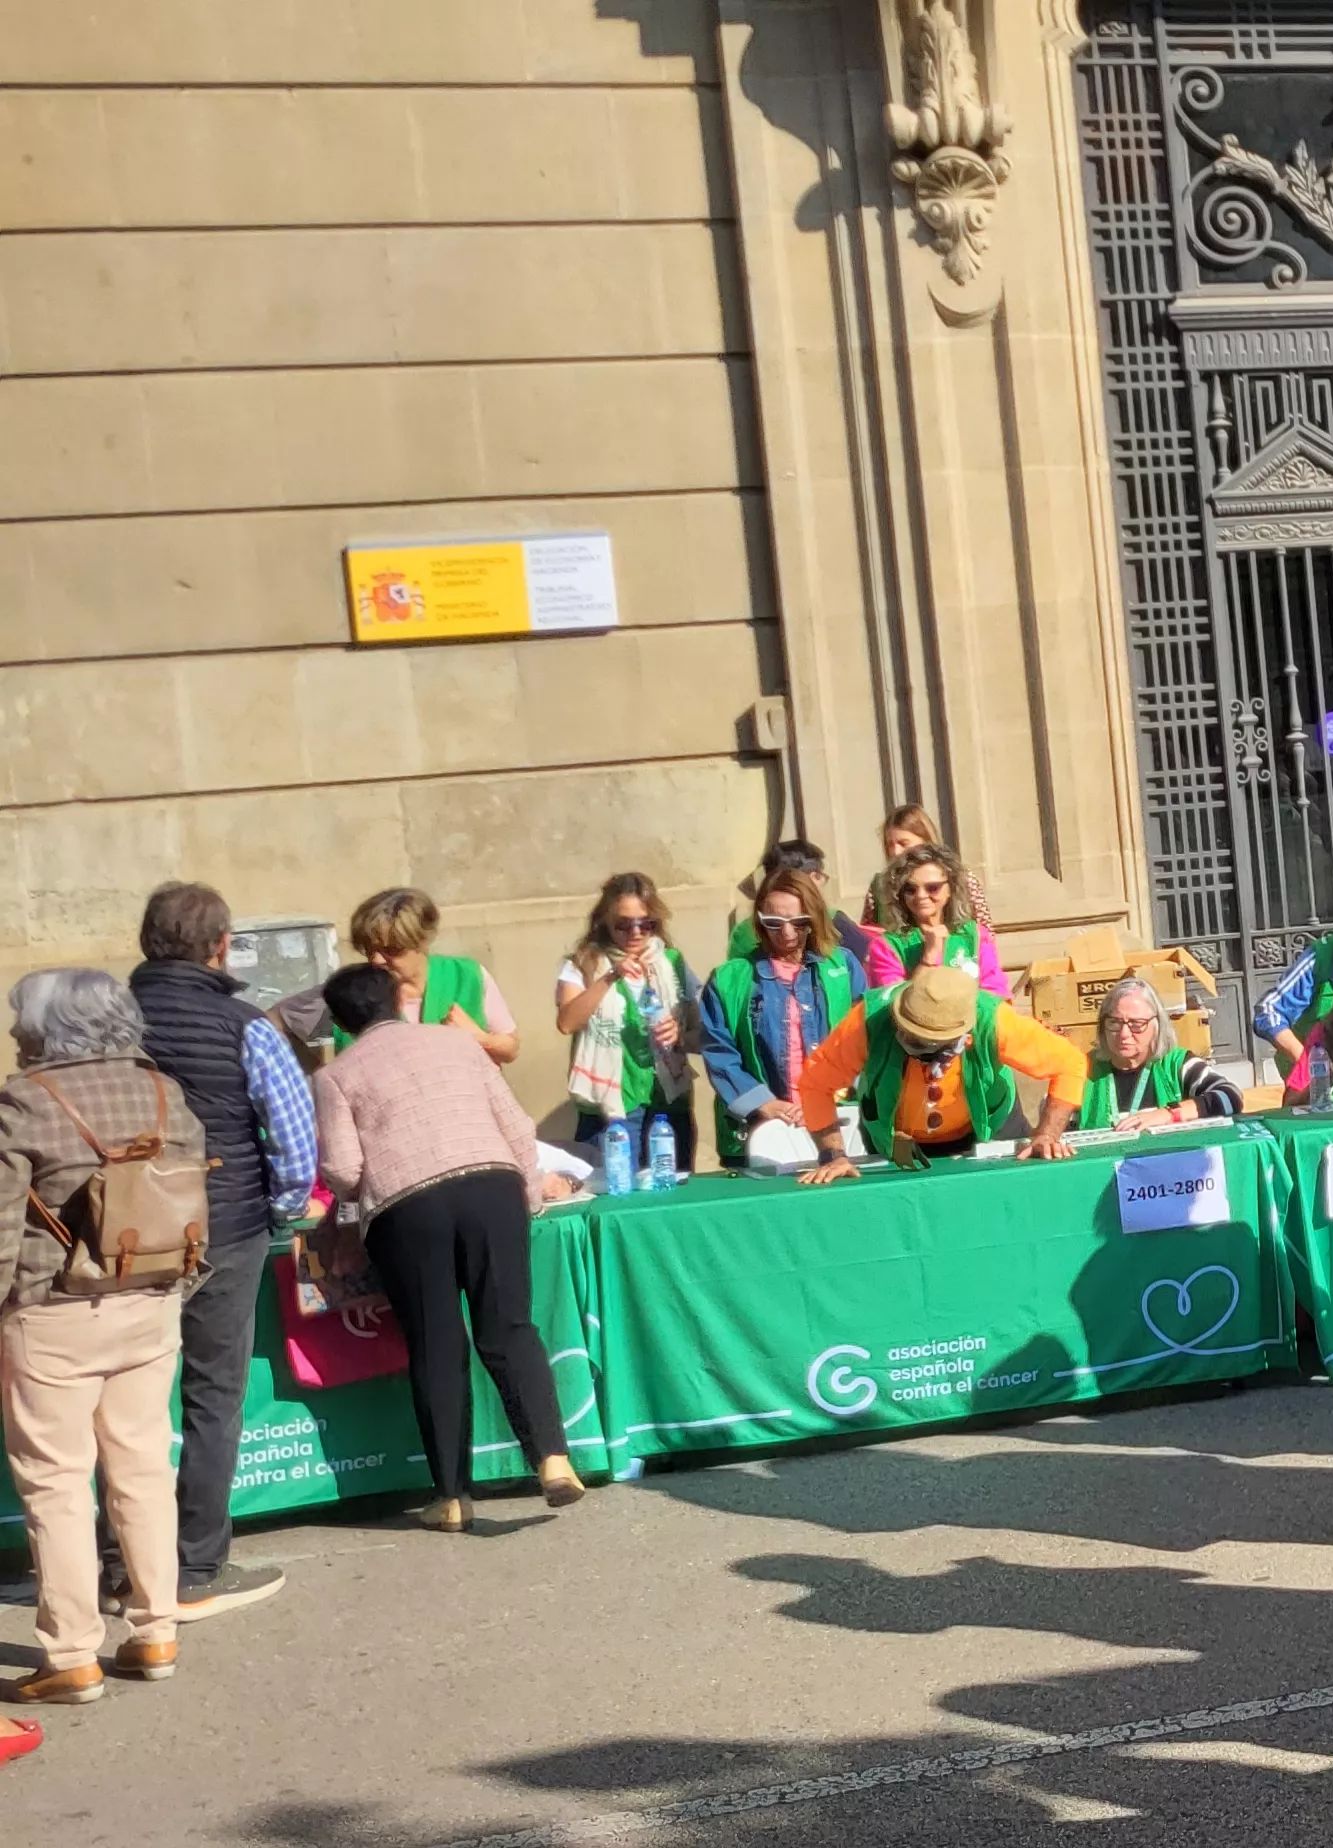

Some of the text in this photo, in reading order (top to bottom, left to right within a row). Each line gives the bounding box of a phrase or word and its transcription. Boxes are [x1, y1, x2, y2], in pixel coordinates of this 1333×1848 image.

[1126, 1177, 1215, 1202] 2401-2800
[888, 1335, 986, 1361] asociación
[889, 1357, 975, 1382] española
[892, 1368, 1039, 1401] contra el cáncer
[240, 1417, 327, 1444] ociación
[239, 1441, 313, 1470] pañola
[231, 1452, 387, 1489] ontra el cáncer
